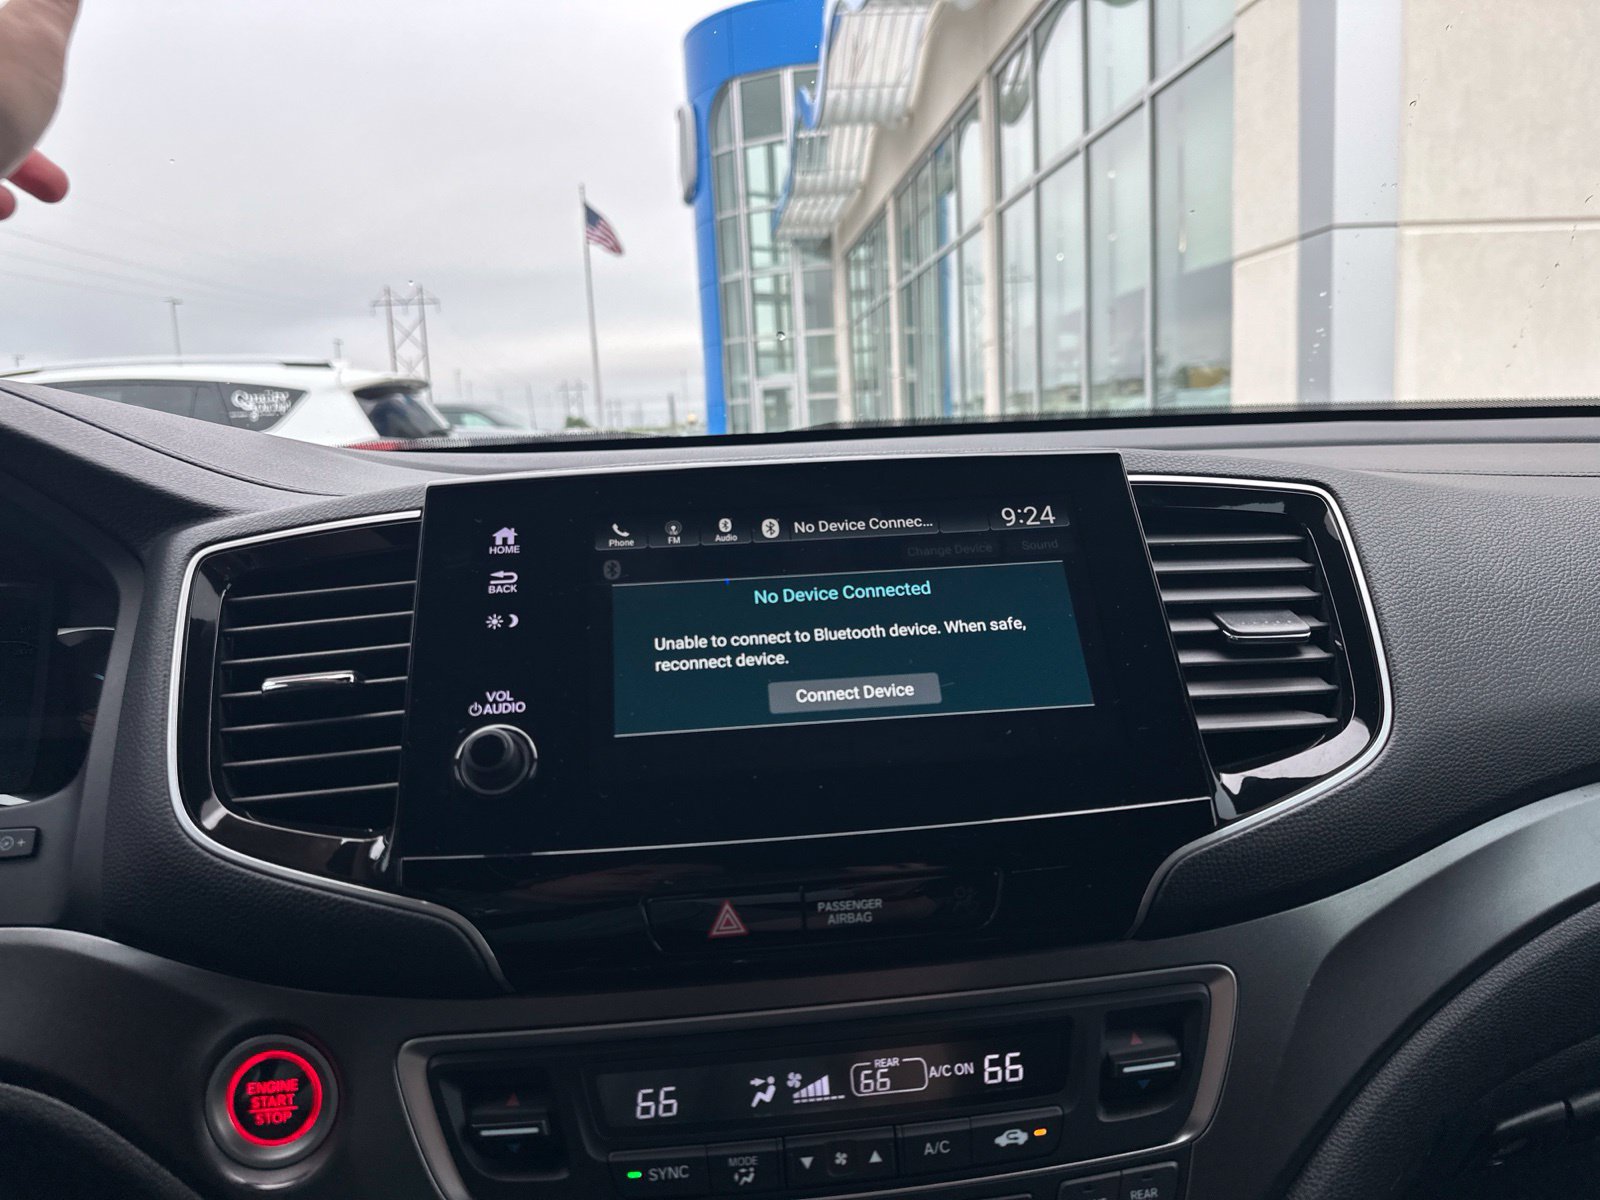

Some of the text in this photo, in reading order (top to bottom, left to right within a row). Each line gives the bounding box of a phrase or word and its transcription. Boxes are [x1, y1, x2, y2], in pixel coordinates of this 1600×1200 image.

[1001, 505, 1056, 527] 9:24
[794, 516, 933, 534] No Device Connec...
[608, 538, 635, 547] Phone
[667, 536, 681, 545] FM
[715, 533, 738, 543] Audio
[1021, 538, 1059, 551] Sound
[489, 545, 520, 554] HOME
[906, 542, 993, 558] Change Device
[488, 584, 517, 593] BACK
[754, 580, 932, 605] No Device Connected
[654, 616, 1027, 651] Unable to connect to Bluetooth device. When safe,
[655, 651, 790, 672] reconnect device.
[485, 690, 514, 702] VOL
[795, 683, 915, 703] Connect Device
[483, 701, 526, 715] AUDIO
[818, 898, 882, 912] PASSENGER
[828, 911, 873, 925] AIRBAG
[874, 1057, 900, 1068] REAR
[928, 1062, 975, 1079] A/C ON
[983, 1052, 1024, 1085] 66
[247, 1078, 298, 1094] ENGINE
[859, 1068, 891, 1093] 66
[251, 1093, 294, 1109] START
[635, 1086, 678, 1120] 66
[255, 1111, 291, 1125] STOP
[924, 1140, 951, 1156] A/C
[728, 1155, 758, 1167] MODE
[649, 1165, 690, 1182] SYNC
[1130, 1187, 1158, 1200] REAR
